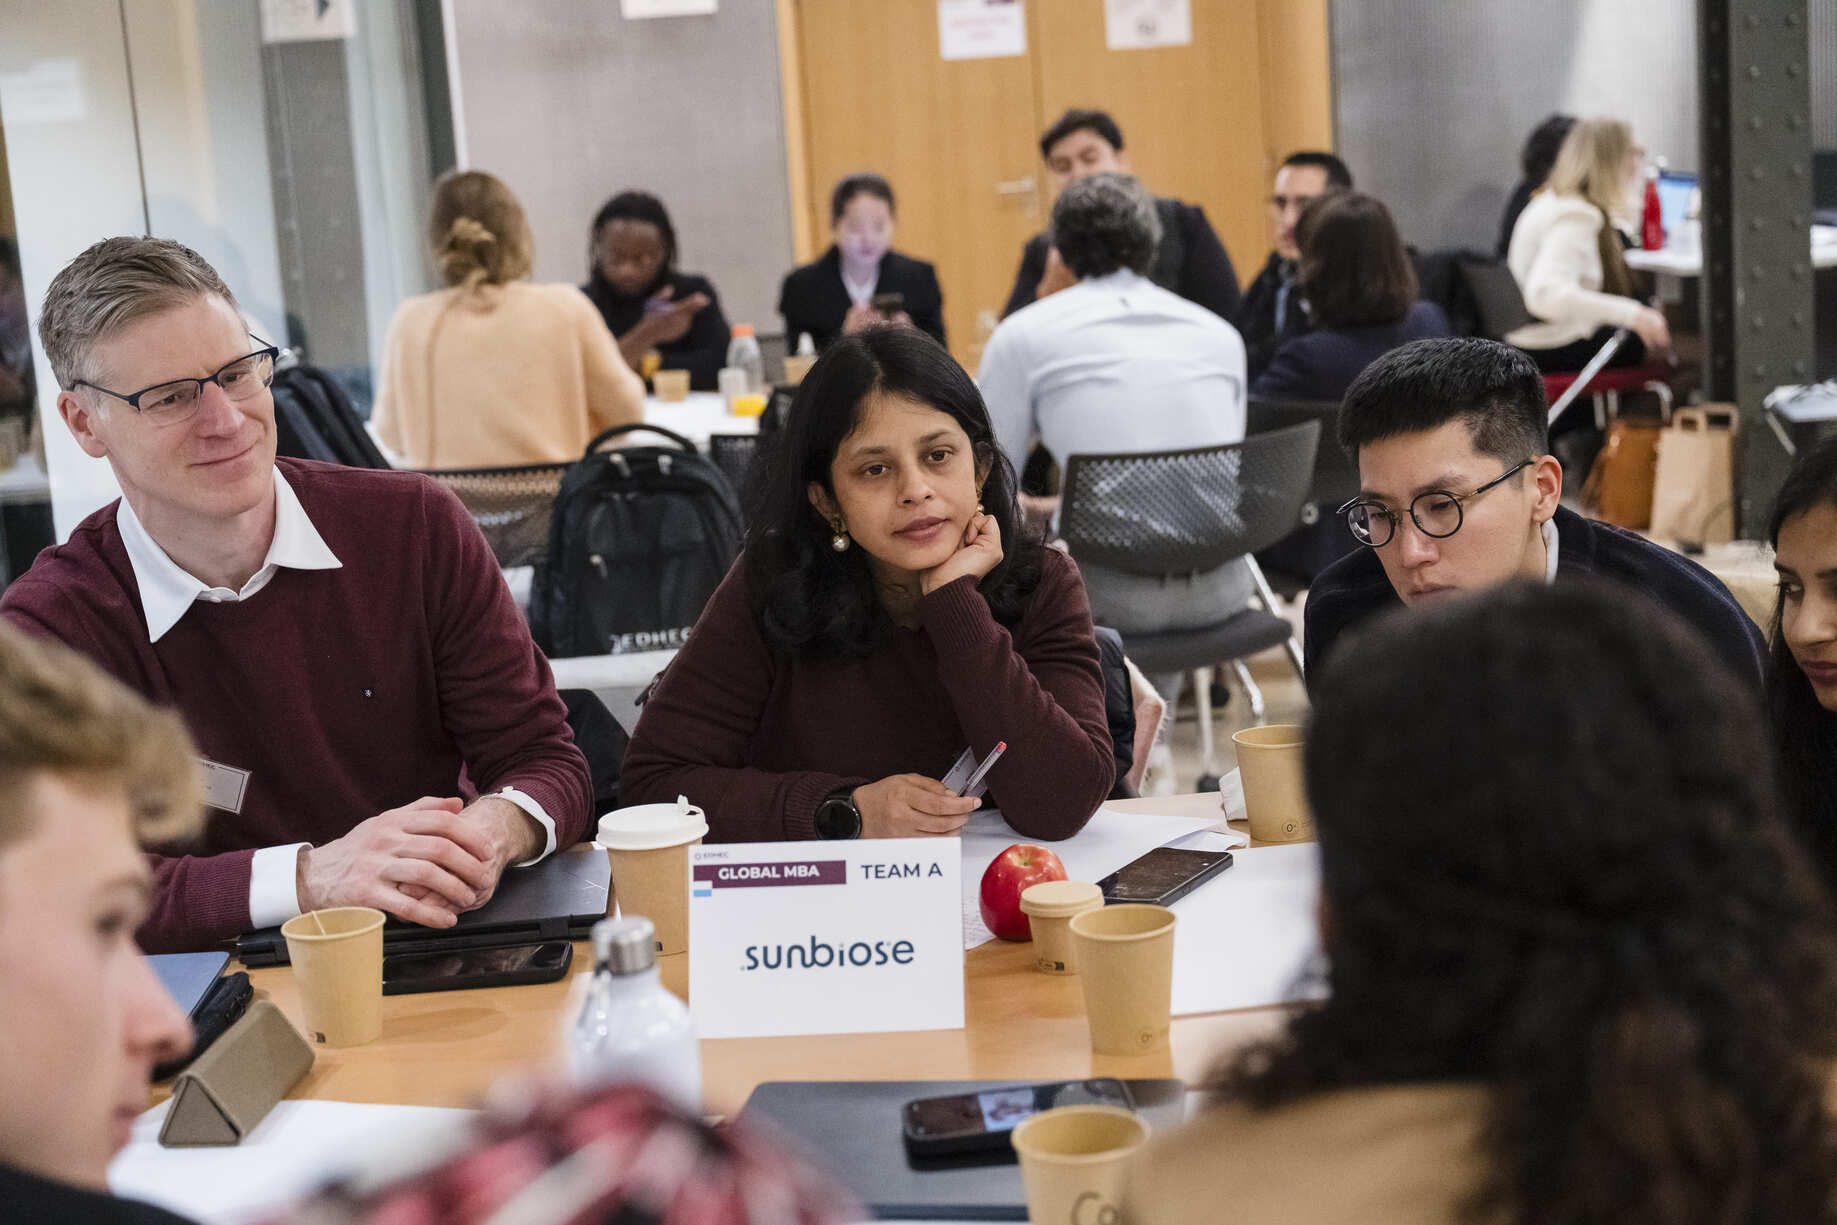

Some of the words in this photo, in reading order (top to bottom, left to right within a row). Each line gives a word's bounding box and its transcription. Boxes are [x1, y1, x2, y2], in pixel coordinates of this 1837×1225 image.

[718, 867, 780, 880] GLOBAL
[783, 864, 820, 878] MBA
[861, 863, 920, 879] TEAM
[928, 862, 943, 877] A
[745, 935, 914, 970] sunbiose
